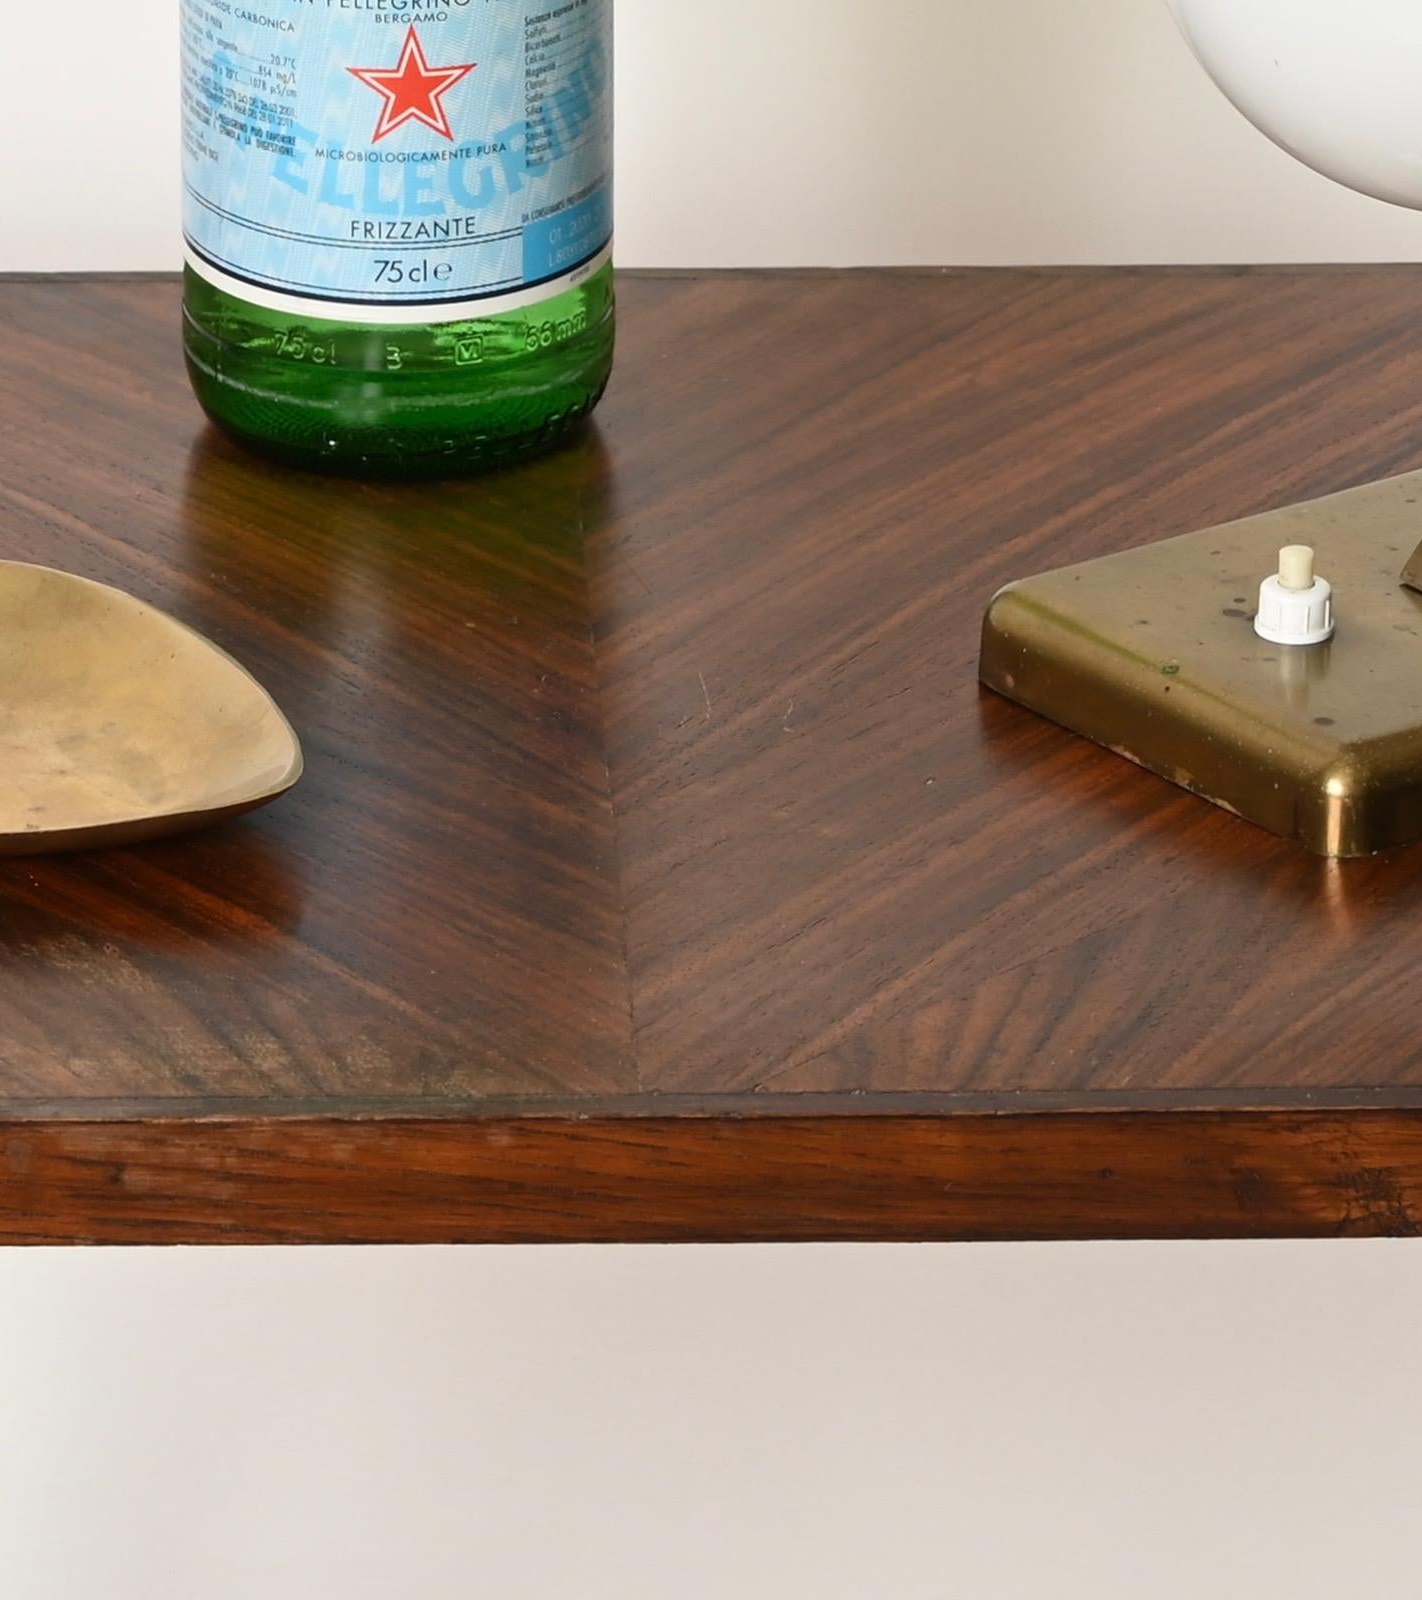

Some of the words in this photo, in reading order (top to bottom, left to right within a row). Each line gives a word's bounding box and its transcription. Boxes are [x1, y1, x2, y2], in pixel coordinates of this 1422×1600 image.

[234, 7, 296, 33] CARBONICA
[374, 11, 449, 24] BERGAMO
[314, 147, 472, 164] MICROBIOLOGICAMENTE
[477, 143, 507, 157] PURA
[350, 216, 476, 240] FRIZZANTE
